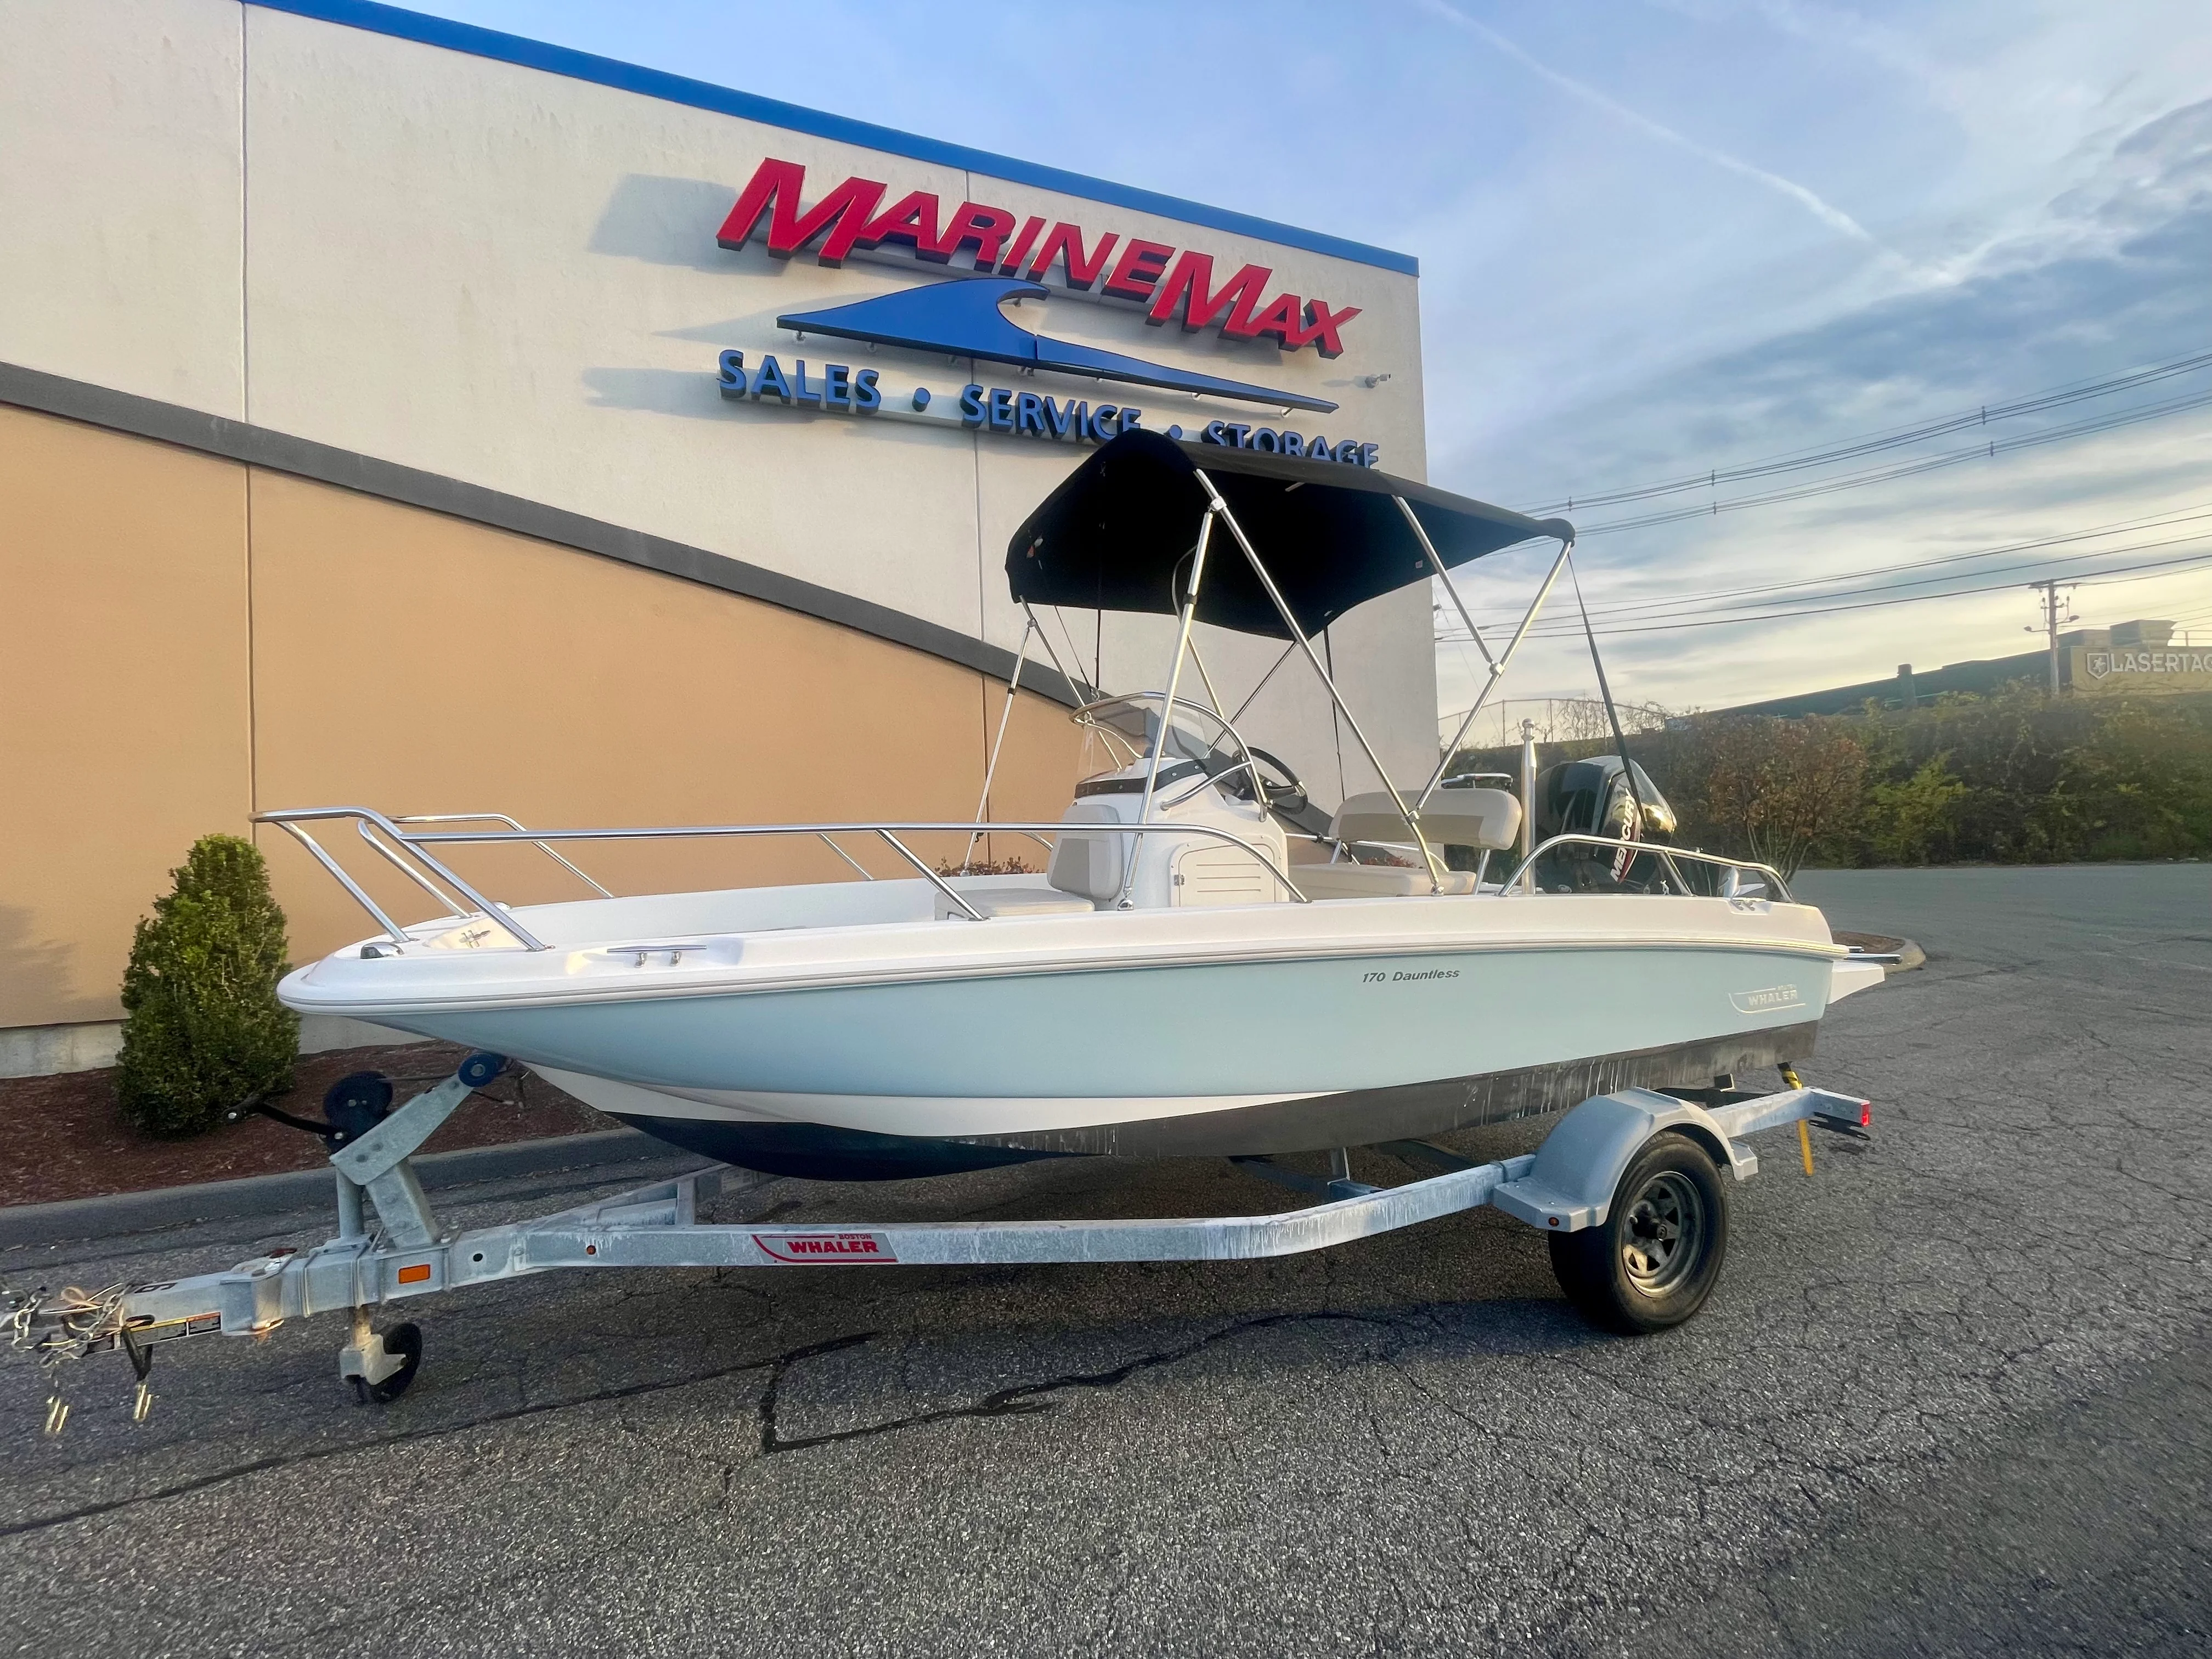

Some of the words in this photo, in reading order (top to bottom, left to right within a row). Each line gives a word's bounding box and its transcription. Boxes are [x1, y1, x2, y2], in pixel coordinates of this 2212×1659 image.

[718, 349, 881, 415] SALES
[1204, 420, 1379, 469] STORAGE
[1610, 788, 1635, 882] MECURY
[1362, 972, 1386, 983] 170
[1392, 969, 1460, 981] Dauntless
[1748, 990, 1798, 1006] WHALER
[787, 1241, 879, 1253] WHALER
